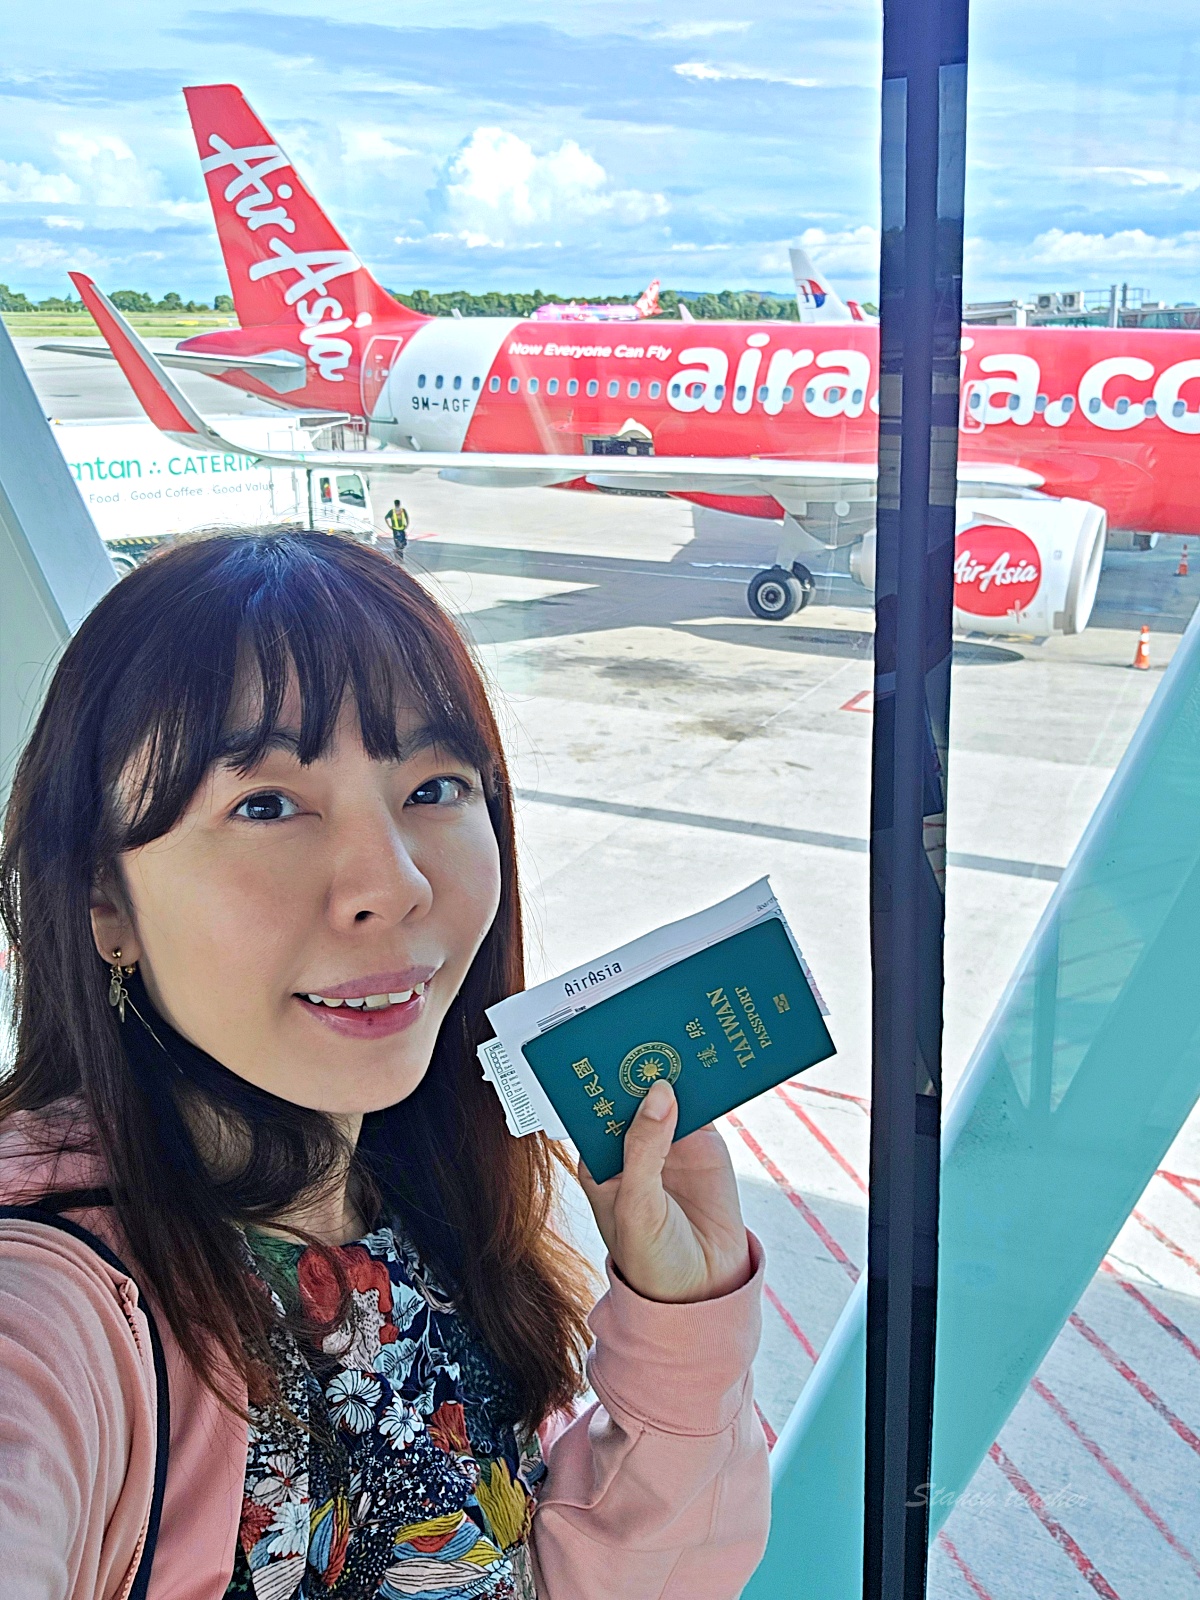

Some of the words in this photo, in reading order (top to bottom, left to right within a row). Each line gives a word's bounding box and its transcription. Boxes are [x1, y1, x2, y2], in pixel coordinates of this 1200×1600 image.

[508, 342, 543, 356] Now
[543, 342, 612, 359] Everyone
[614, 344, 645, 358] Can
[645, 344, 673, 361] Fly
[411, 396, 471, 412] 9M-AGF
[168, 453, 271, 475] CATERIN
[89, 493, 120, 503] Food
[130, 489, 161, 501] Good
[165, 487, 203, 498] Coffee
[212, 483, 242, 495] Good
[564, 962, 622, 997] AirAsia
[705, 987, 756, 1069] TAIWAN
[734, 986, 773, 1049] PASSPORT
[685, 1017, 719, 1068] 護照
[571, 1057, 626, 1137] 中華民國
